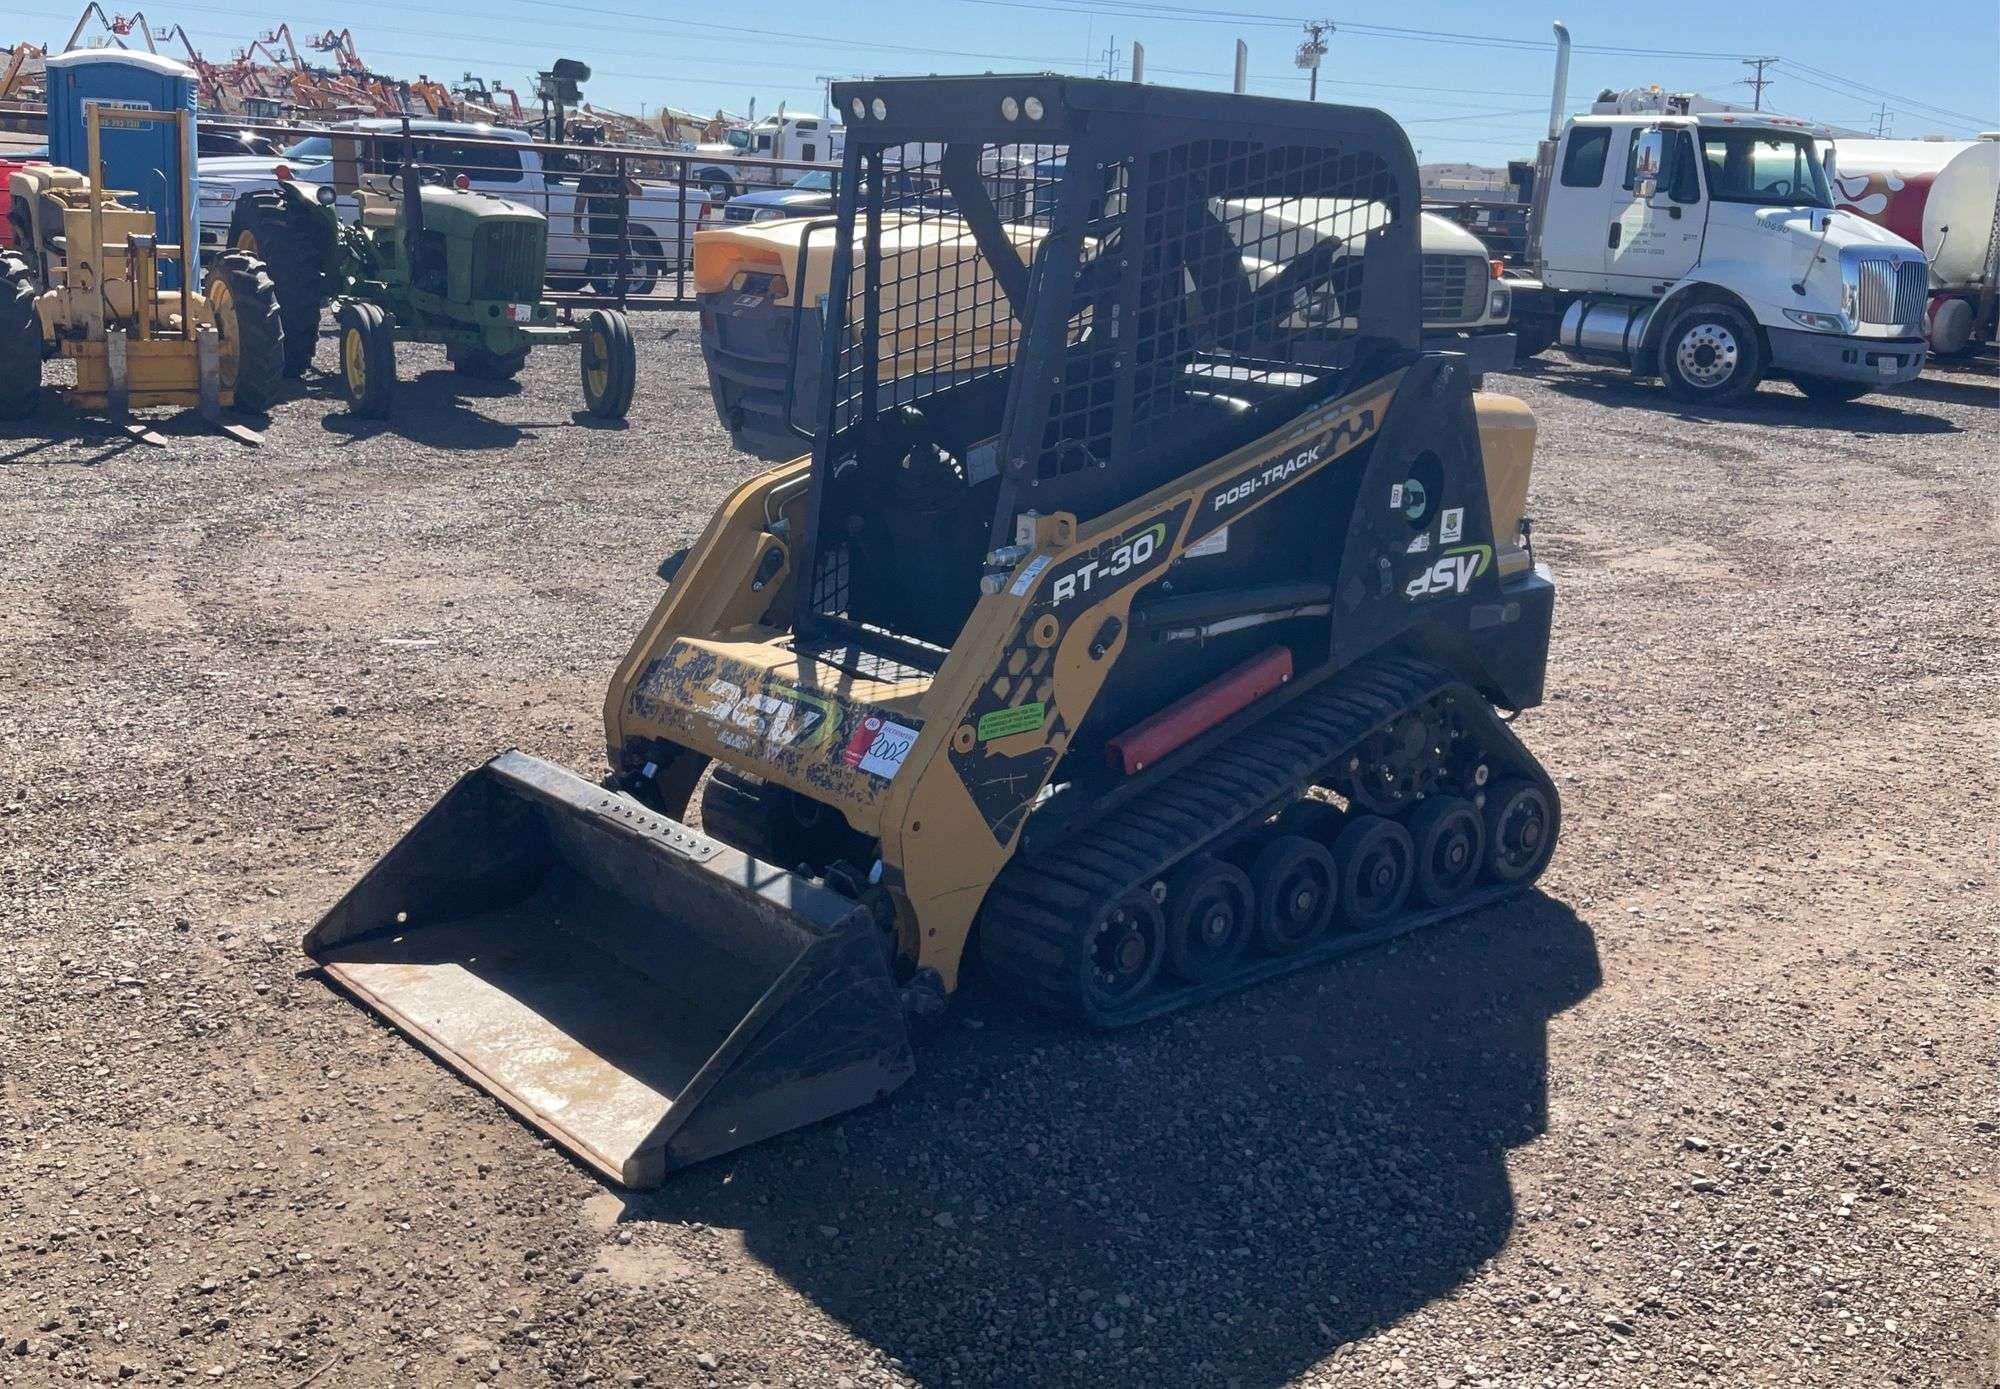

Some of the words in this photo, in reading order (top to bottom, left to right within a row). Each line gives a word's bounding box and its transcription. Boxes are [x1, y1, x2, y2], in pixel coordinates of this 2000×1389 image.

[1214, 445, 1320, 511] POSI-TRACK
[1052, 534, 1154, 607] RT-30
[868, 733, 910, 764] 2002
